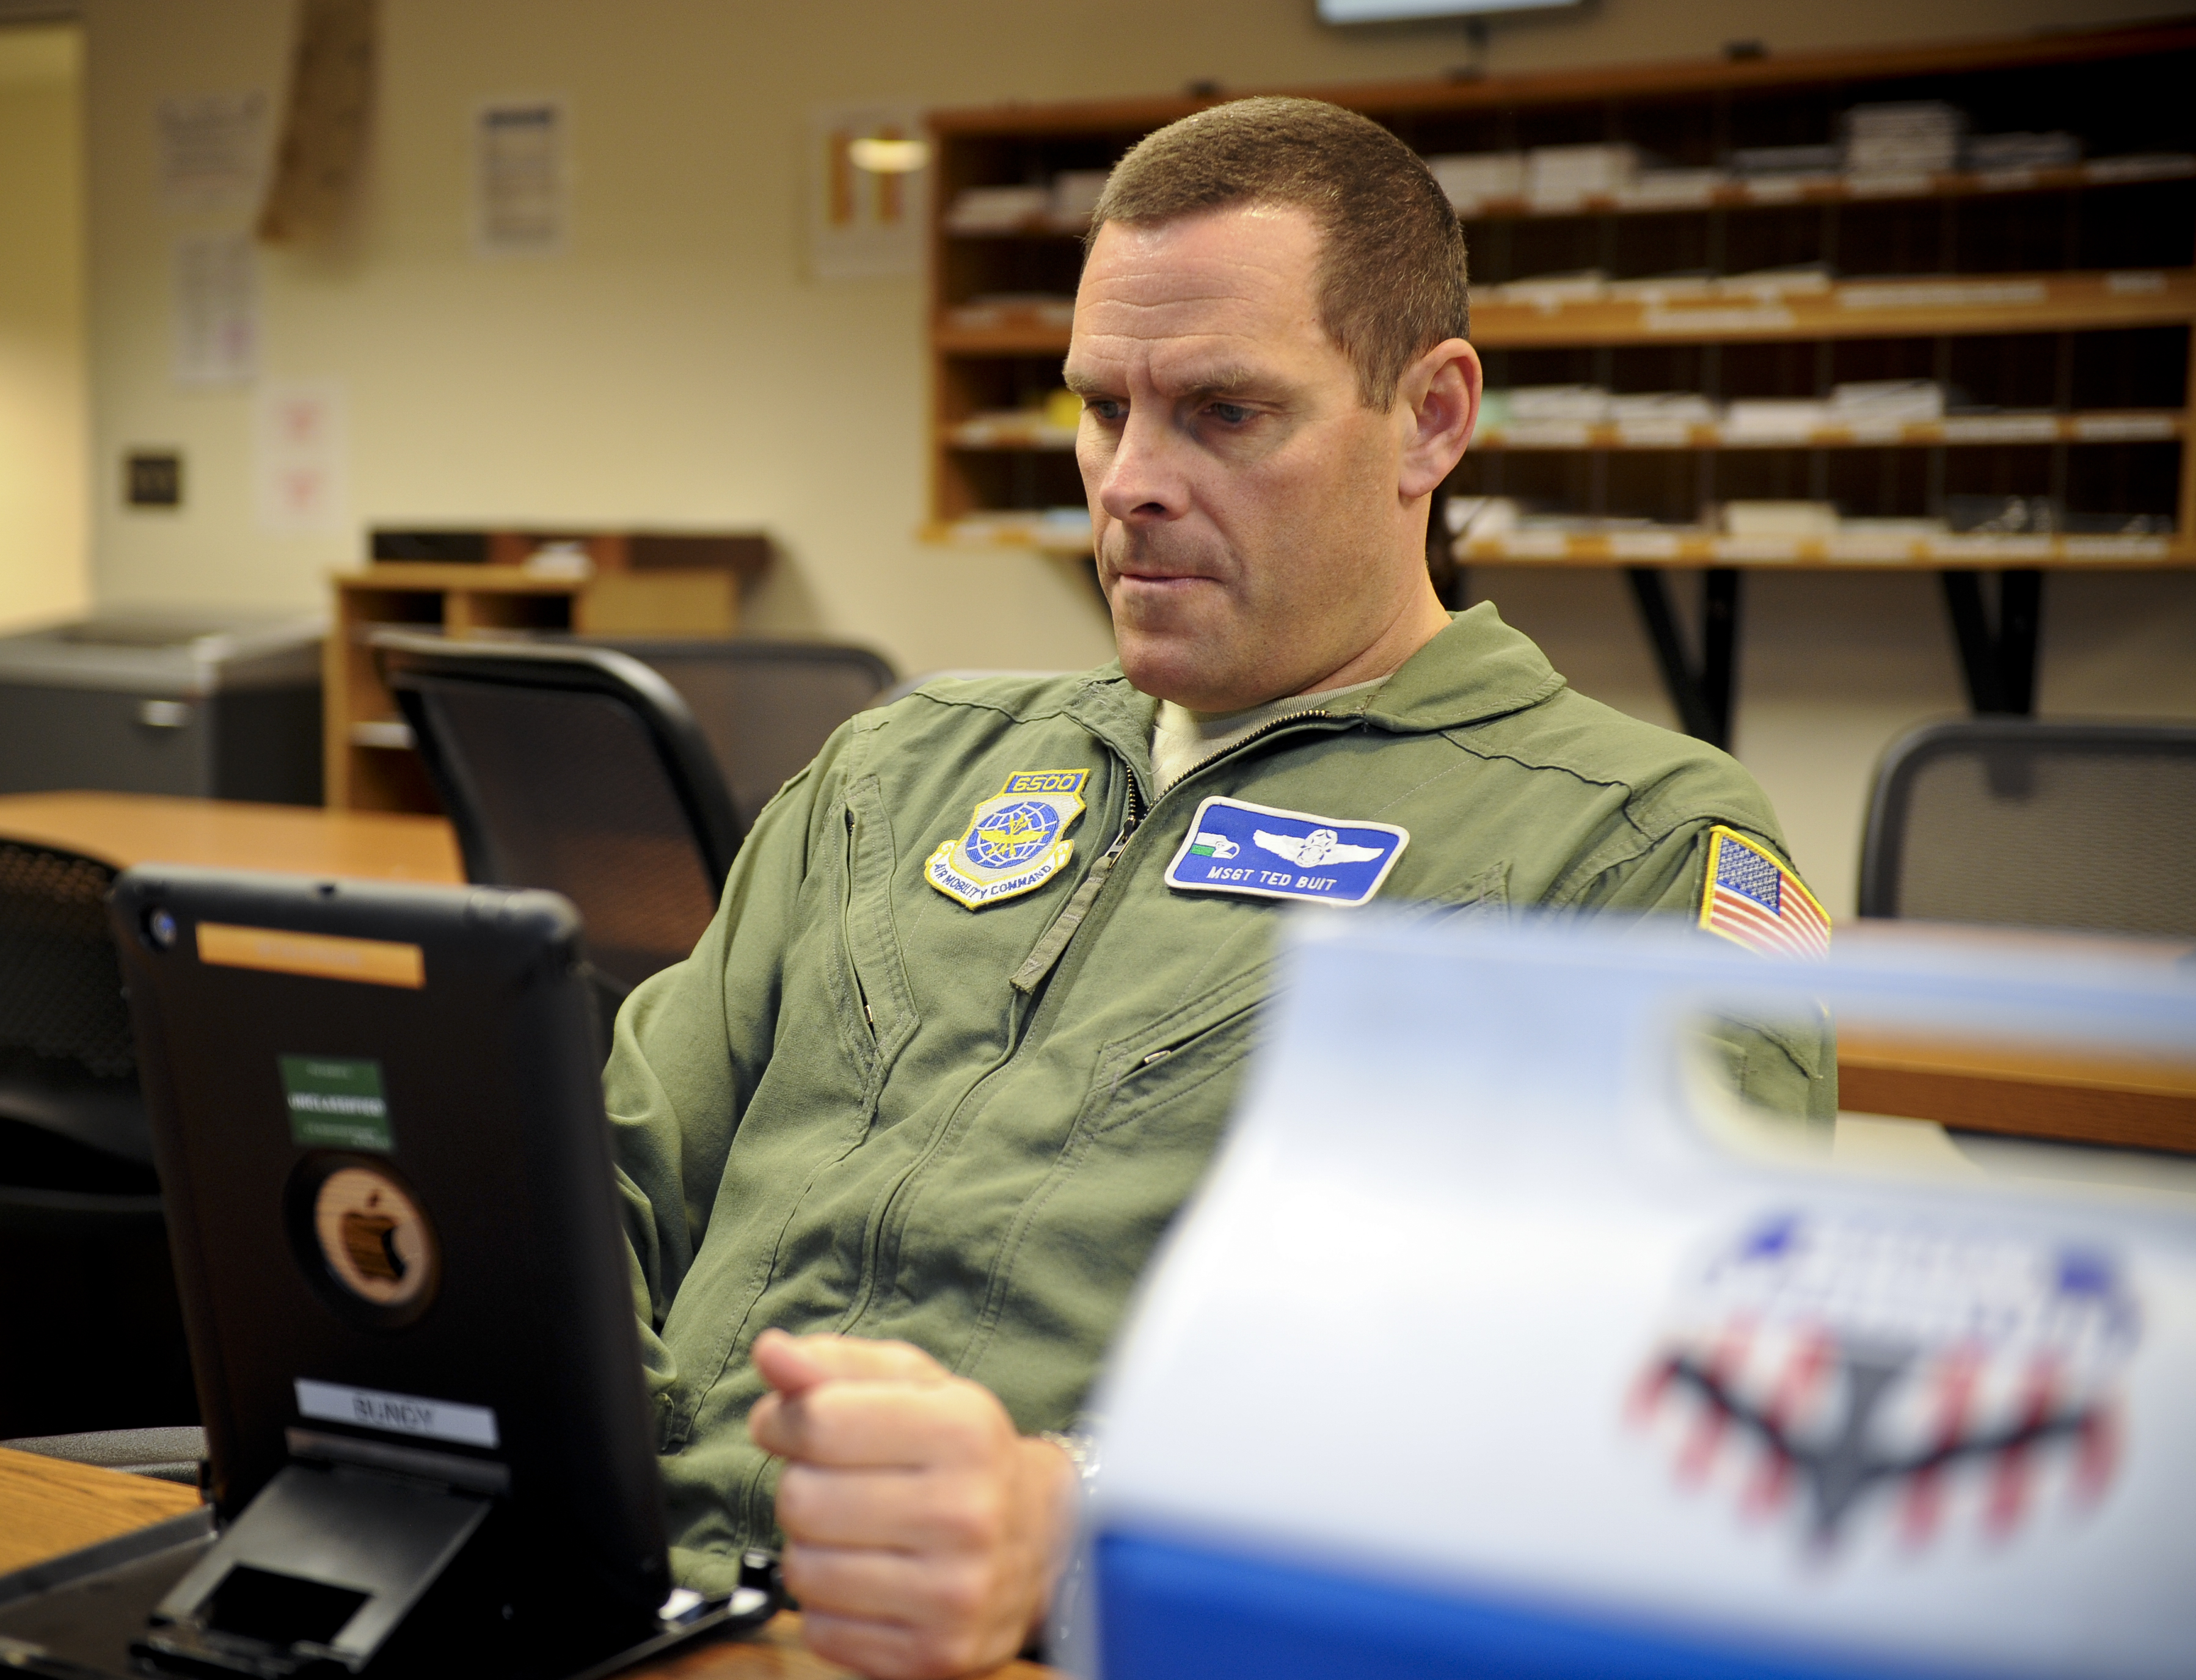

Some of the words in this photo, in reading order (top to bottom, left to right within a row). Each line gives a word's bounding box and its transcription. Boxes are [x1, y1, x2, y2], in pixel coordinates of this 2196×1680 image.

[1013, 775, 1076, 791] 6500
[934, 864, 947, 878] AIR
[943, 876, 987, 899] MOBILITY
[990, 865, 1052, 895] COMMAND
[1207, 866, 1255, 881] MSGT
[1260, 870, 1291, 886] TED
[1296, 876, 1337, 891] BUIT
